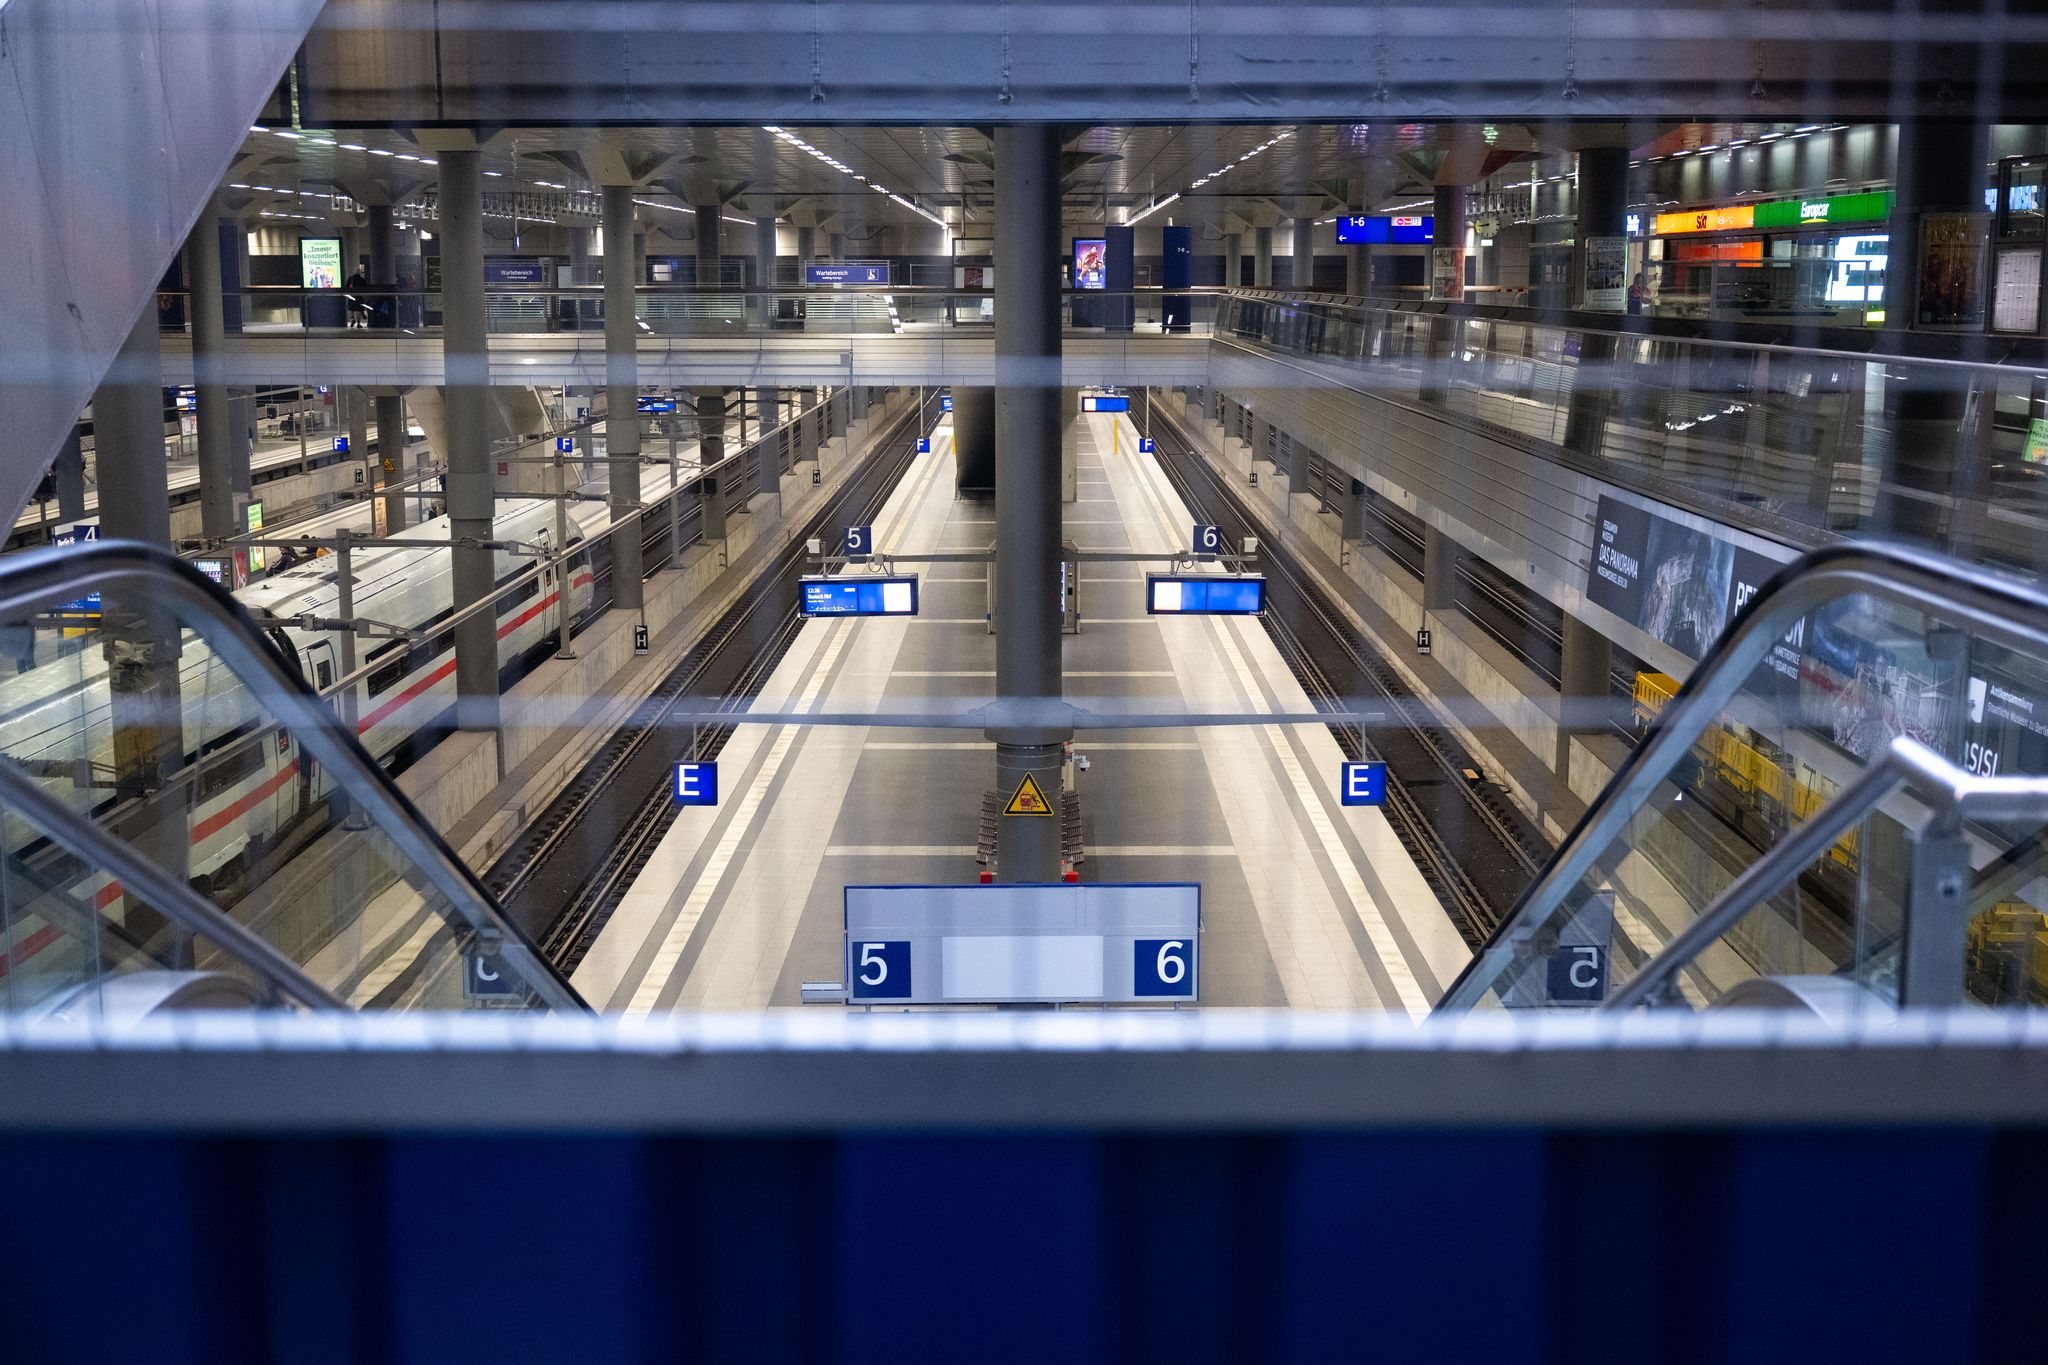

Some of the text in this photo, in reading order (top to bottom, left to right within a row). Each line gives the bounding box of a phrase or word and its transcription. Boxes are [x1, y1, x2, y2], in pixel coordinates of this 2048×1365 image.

[1800, 201, 1830, 220] Europcar
[1349, 217, 1365, 227] 1-6
[581, 408, 588, 417] 4
[334, 438, 342, 450] F
[562, 438, 570, 450] F
[917, 438, 924, 450] F
[1144, 438, 1152, 450] F
[813, 474, 820, 482] H
[1250, 474, 1257, 482] H
[84, 526, 98, 543] 4
[847, 527, 861, 549] 5
[1203, 526, 1217, 548] 6
[1599, 543, 1638, 580] DAS PANORAMA
[637, 634, 647, 647] H
[1419, 632, 1428, 645] H
[679, 764, 700, 796] E
[1348, 764, 1369, 796] E
[859, 942, 888, 986] 5
[1156, 941, 1186, 984] 6
